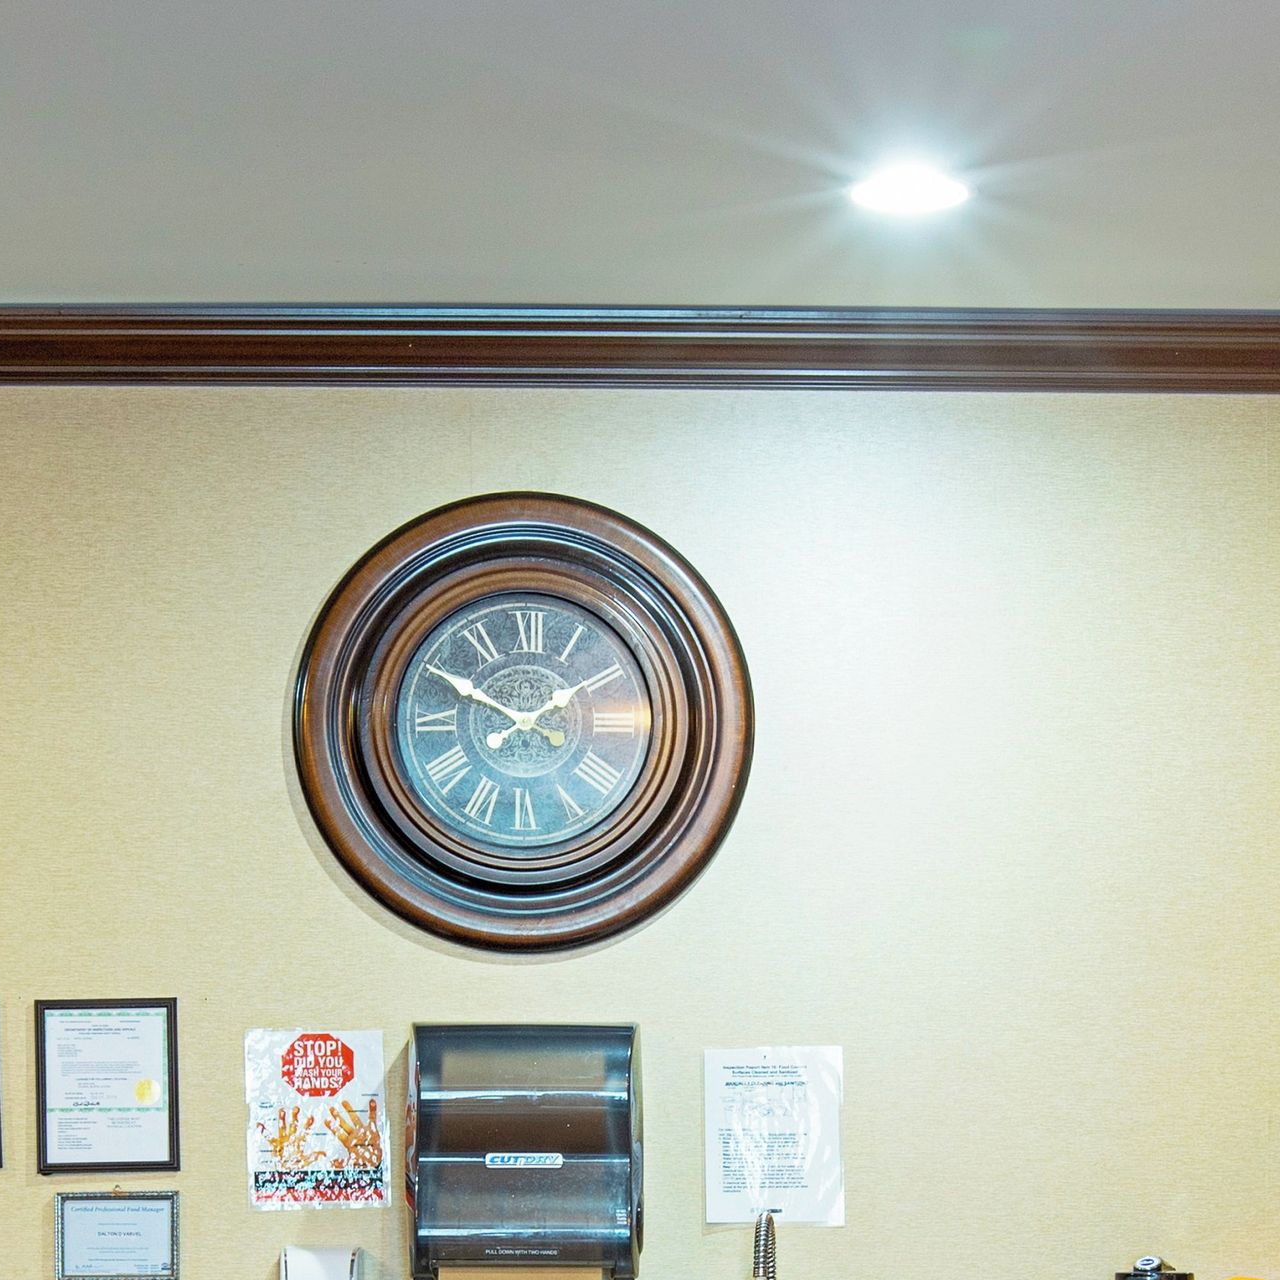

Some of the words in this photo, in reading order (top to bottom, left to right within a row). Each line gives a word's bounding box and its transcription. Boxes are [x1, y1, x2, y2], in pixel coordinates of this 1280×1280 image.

[508, 611, 548, 654] XII
[592, 705, 635, 738] III
[293, 1040, 342, 1056] STOP!
[294, 1056, 315, 1068] DID
[317, 1056, 343, 1068] YOU
[320, 1068, 343, 1077] YOUR
[294, 1077, 343, 1089] HANDS?
[489, 1156, 520, 1164] CUT
